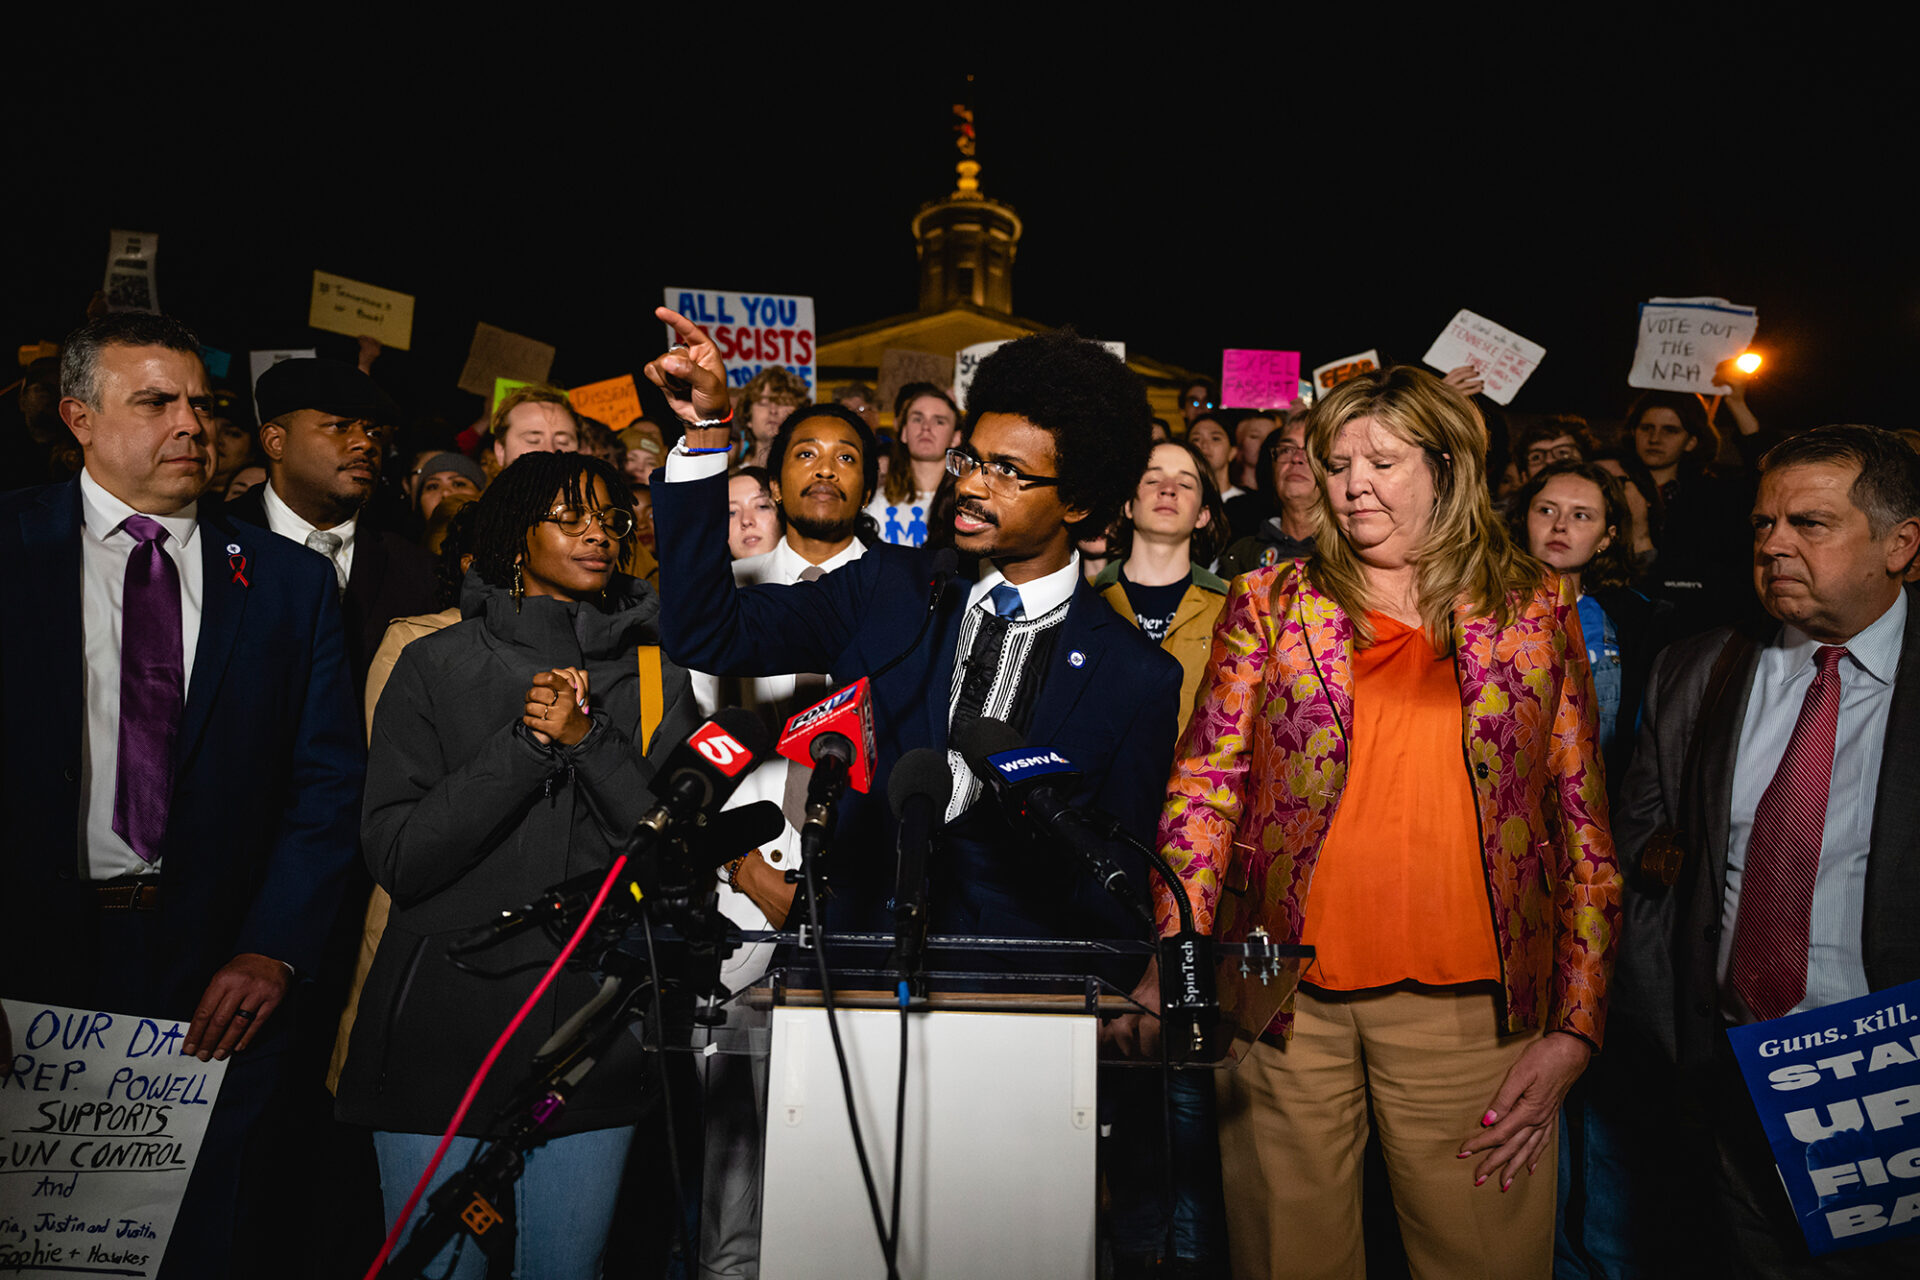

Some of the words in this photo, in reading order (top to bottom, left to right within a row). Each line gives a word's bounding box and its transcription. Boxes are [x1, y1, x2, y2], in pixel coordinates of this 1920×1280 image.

[678, 293, 734, 324] ALL
[740, 296, 797, 327] YOU
[1646, 317, 1693, 335] VOTE
[1700, 321, 1738, 338] OUT
[675, 325, 813, 365] SCISTS
[1660, 340, 1695, 356] THE
[1652, 359, 1701, 382] NRA
[698, 735, 745, 765] 5
[1180, 941, 1200, 1002] SpinTech
[26, 1010, 113, 1050] OUR
[126, 1019, 192, 1057] DA
[1758, 1028, 1848, 1058] Guns.
[1853, 1003, 1918, 1037] Kill.
[1, 1054, 86, 1091] REP.
[107, 1067, 208, 1104] POWELL
[1768, 1034, 1920, 1092] STA
[29, 1100, 173, 1135] SUPPORTS
[70, 1141, 186, 1168] CONTROL
[32, 1173, 79, 1198] And
[34, 1213, 85, 1233] Justin
[87, 1219, 110, 1234] and
[115, 1219, 156, 1239] Justin
[87, 1243, 149, 1266] Hawkes
